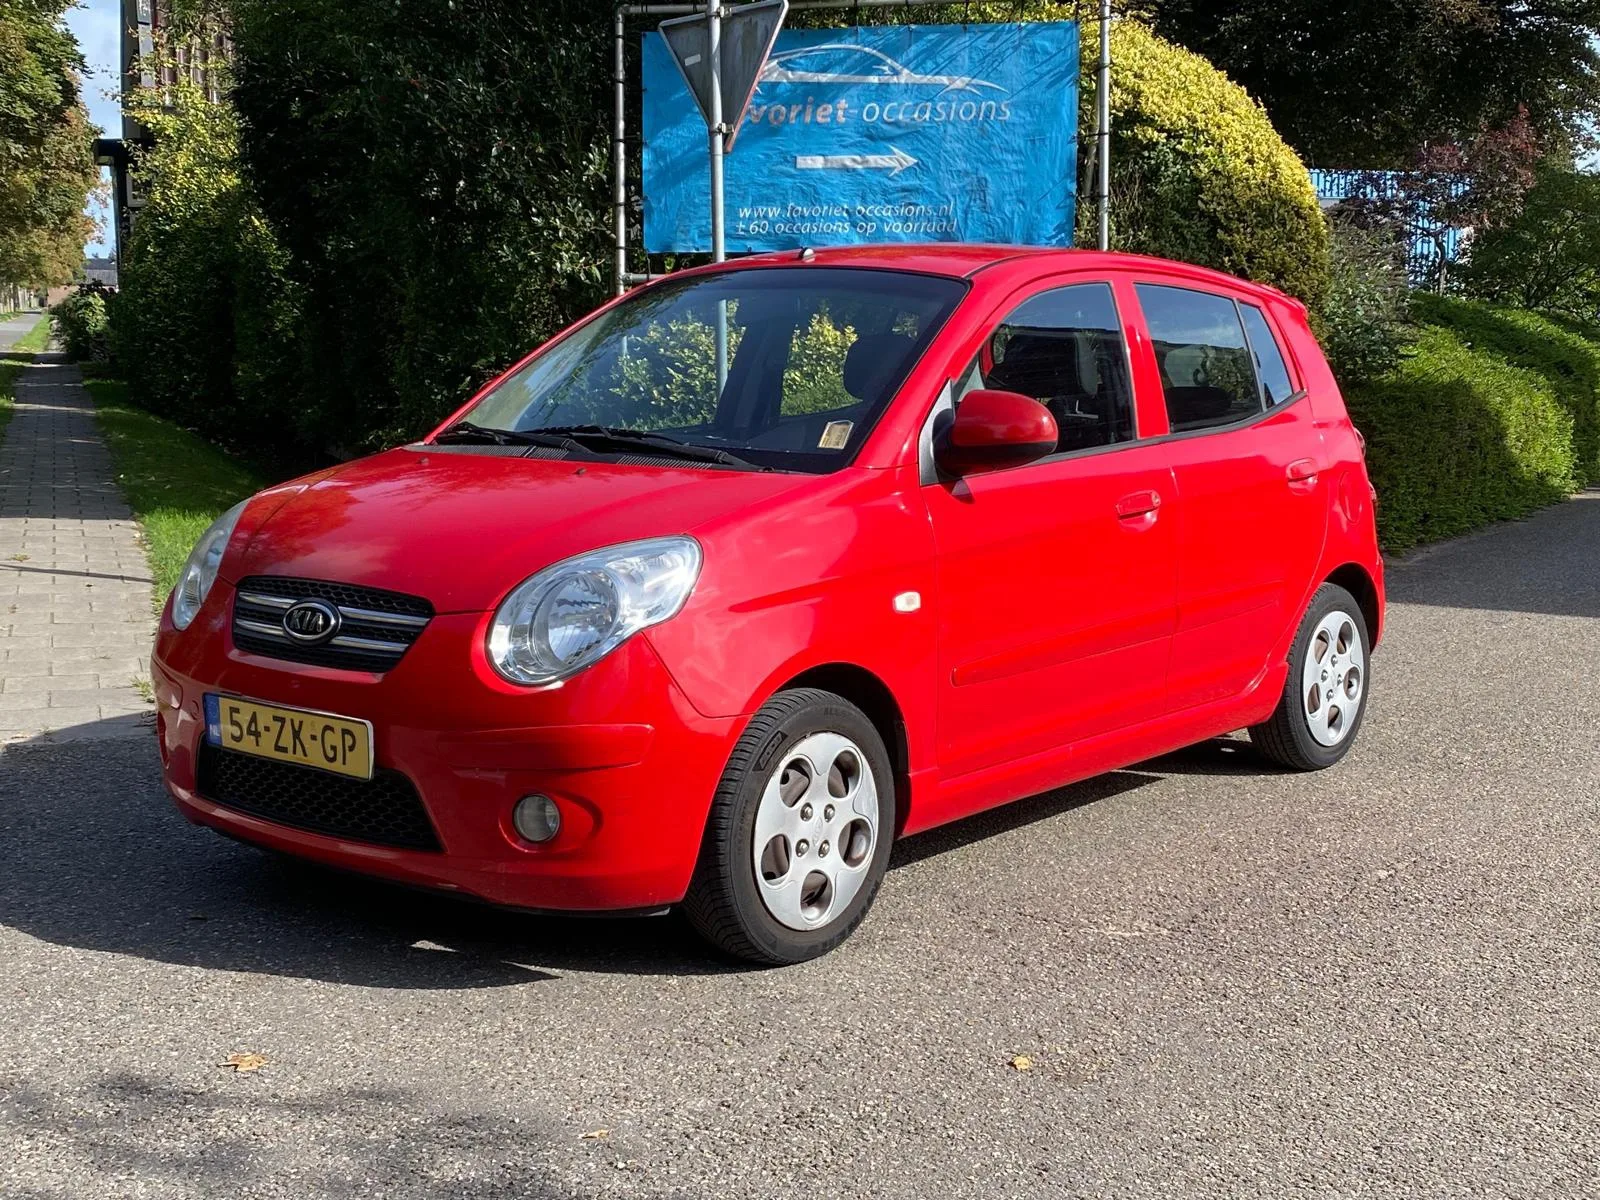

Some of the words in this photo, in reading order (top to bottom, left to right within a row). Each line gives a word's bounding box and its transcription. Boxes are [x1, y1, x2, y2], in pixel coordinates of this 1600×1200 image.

[774, 219, 850, 234] occasions
[856, 221, 877, 237] op
[883, 218, 957, 233] voorraad
[290, 609, 323, 633] KIA
[228, 706, 357, 765] 54-ZK-GP
